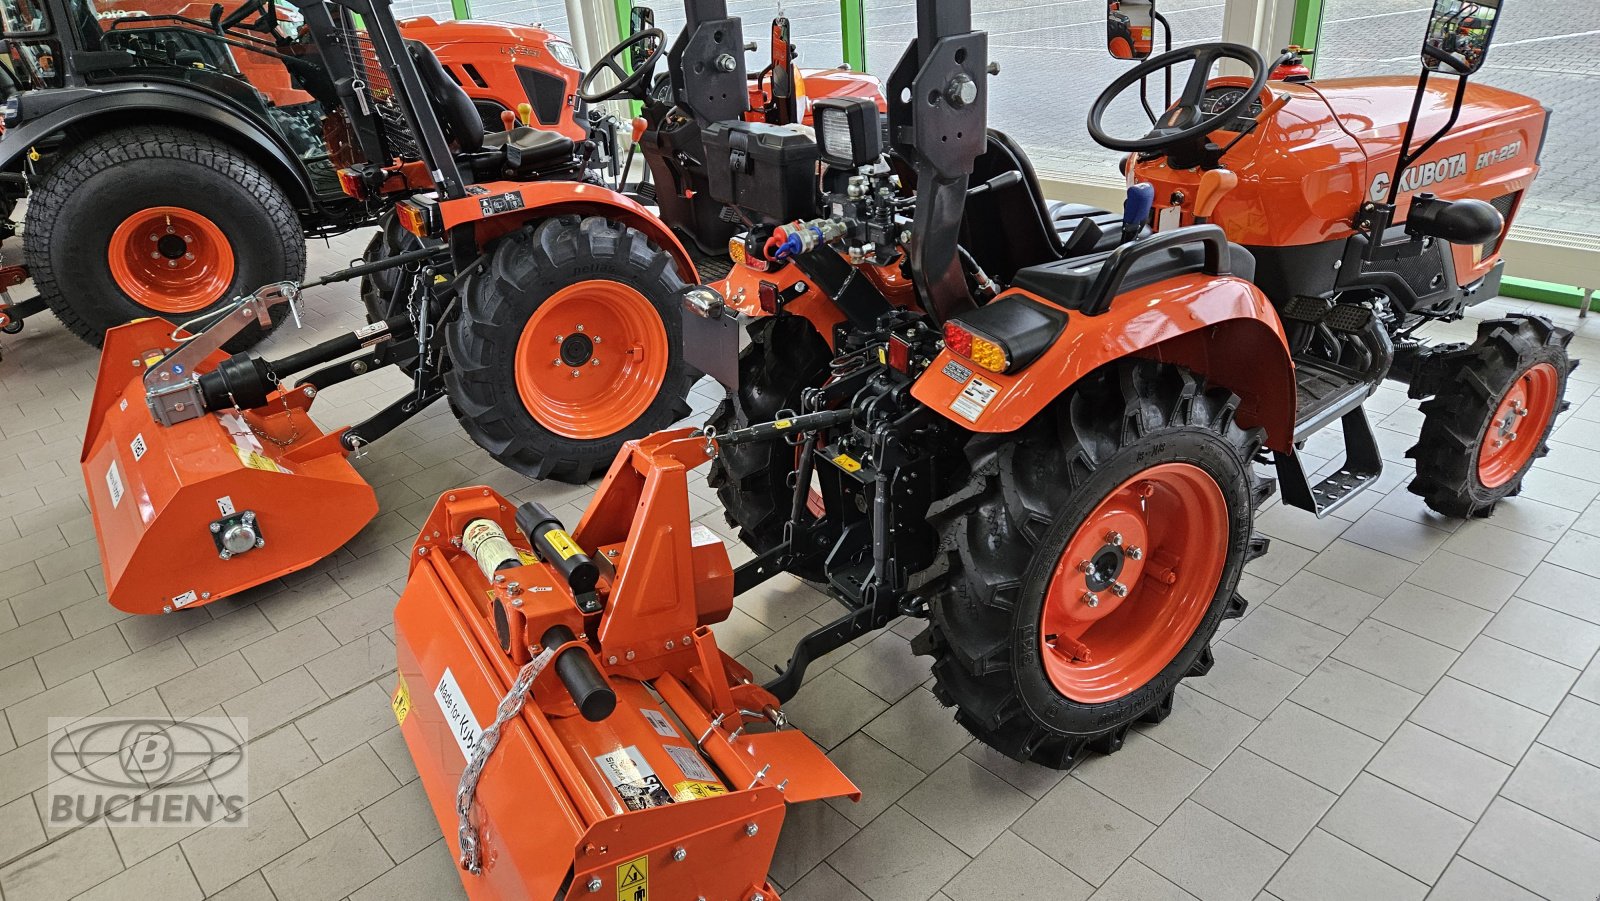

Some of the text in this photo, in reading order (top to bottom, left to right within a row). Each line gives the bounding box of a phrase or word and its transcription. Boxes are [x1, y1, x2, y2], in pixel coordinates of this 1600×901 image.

[1397, 140, 1522, 194] KUBOTA EK1-221
[438, 679, 454, 709] Made
[450, 703, 461, 722] for
